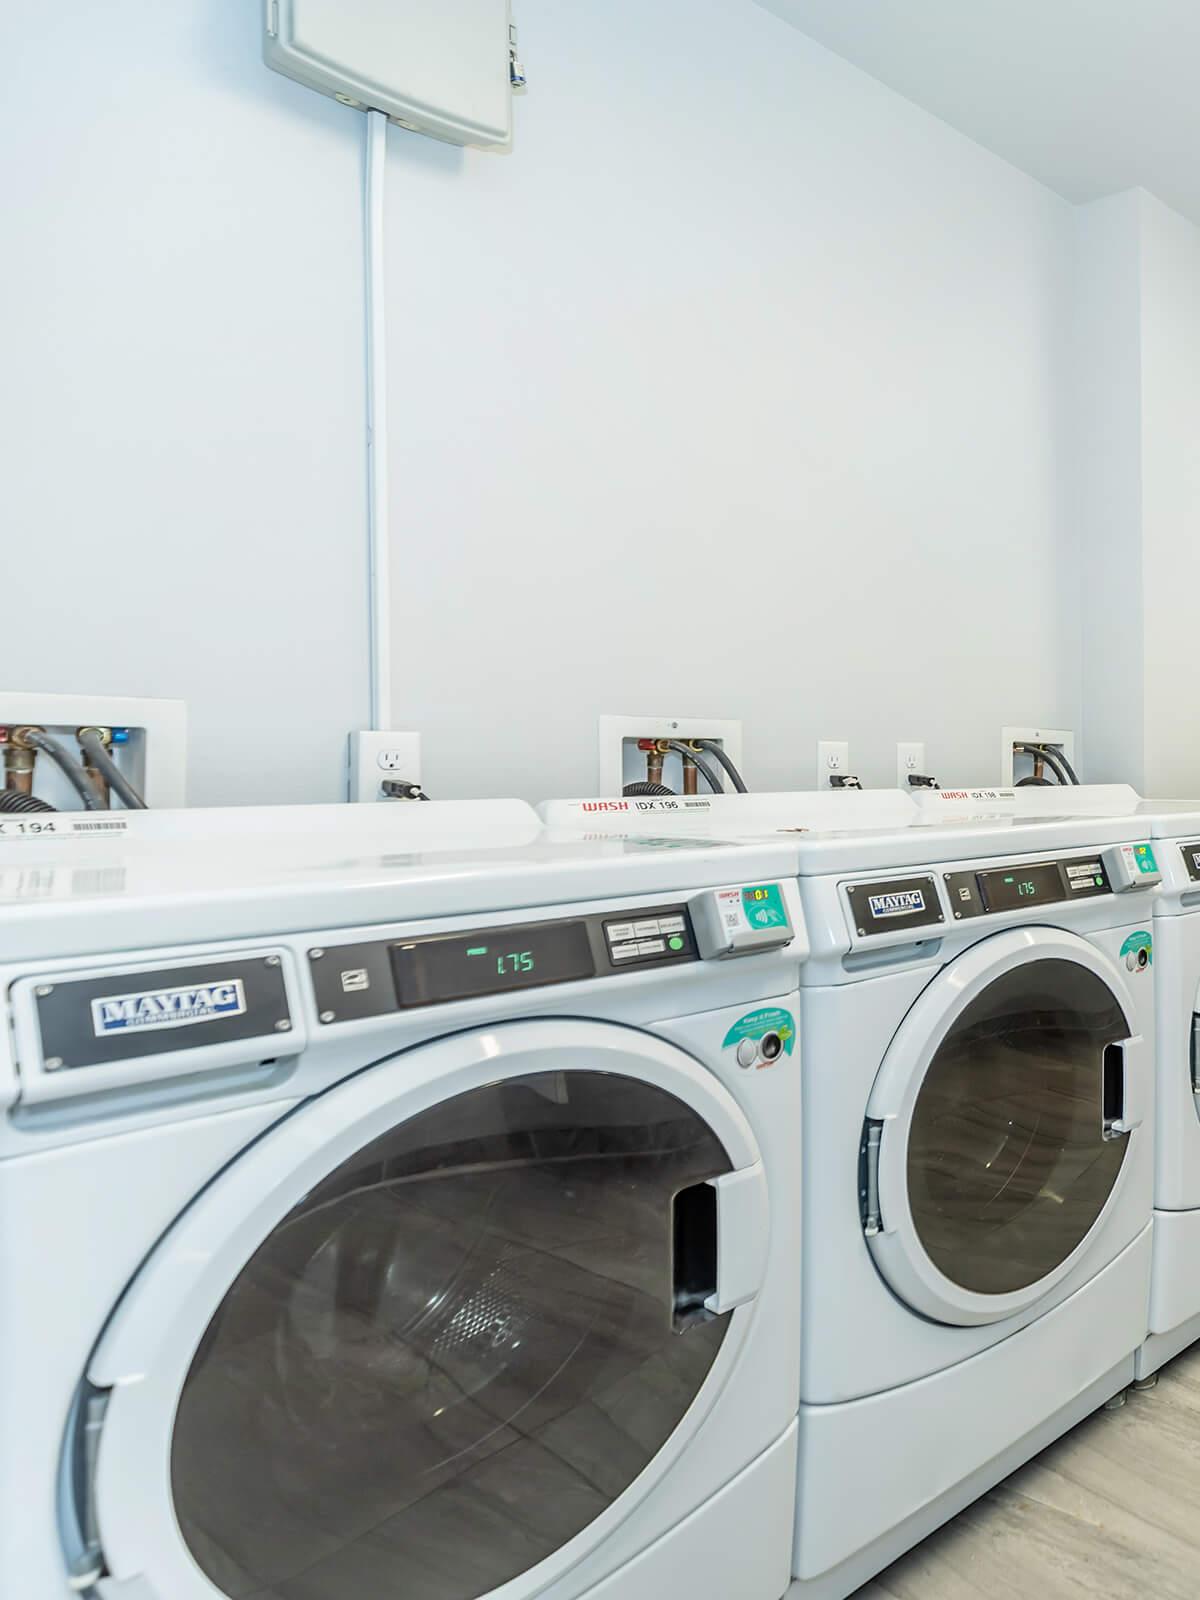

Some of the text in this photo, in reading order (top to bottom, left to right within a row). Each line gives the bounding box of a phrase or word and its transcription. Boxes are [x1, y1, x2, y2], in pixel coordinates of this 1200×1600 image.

[941, 791, 968, 799] WASH
[582, 801, 678, 811] WASH IDX 196
[16, 822, 56, 833] 194
[872, 892, 920, 910] MAYTAG
[103, 984, 236, 1022] MAYTAG
